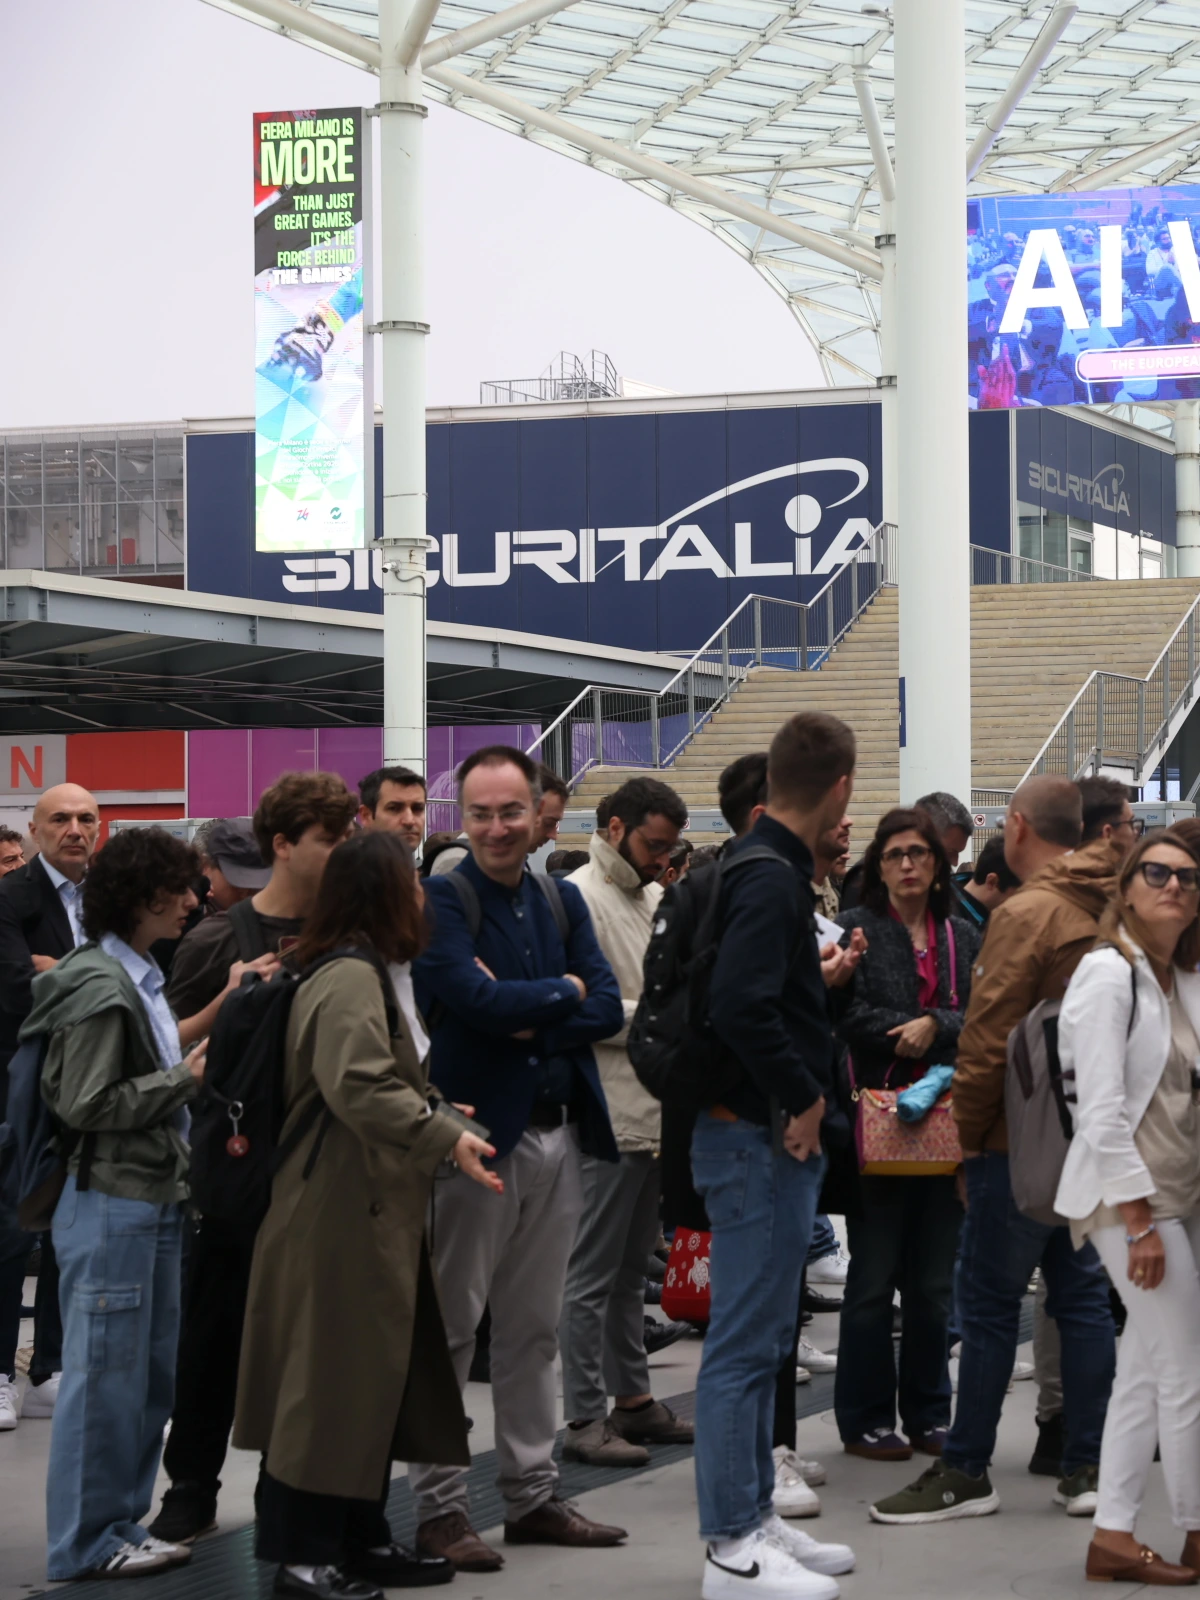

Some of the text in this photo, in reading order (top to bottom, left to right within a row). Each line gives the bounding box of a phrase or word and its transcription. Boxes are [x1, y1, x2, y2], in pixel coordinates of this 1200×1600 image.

[260, 117, 354, 140] FIERA MILANO IS
[260, 137, 355, 187] MORE
[293, 193, 355, 211] THAN JUST
[274, 211, 355, 231] GREAT GAMES.
[311, 230, 355, 247] IT'S THE
[278, 249, 356, 267] FORCE BEHIND
[272, 269, 299, 285] THE
[998, 224, 1124, 334] AI
[1111, 358, 1135, 371] THE
[10, 745, 43, 789] N
